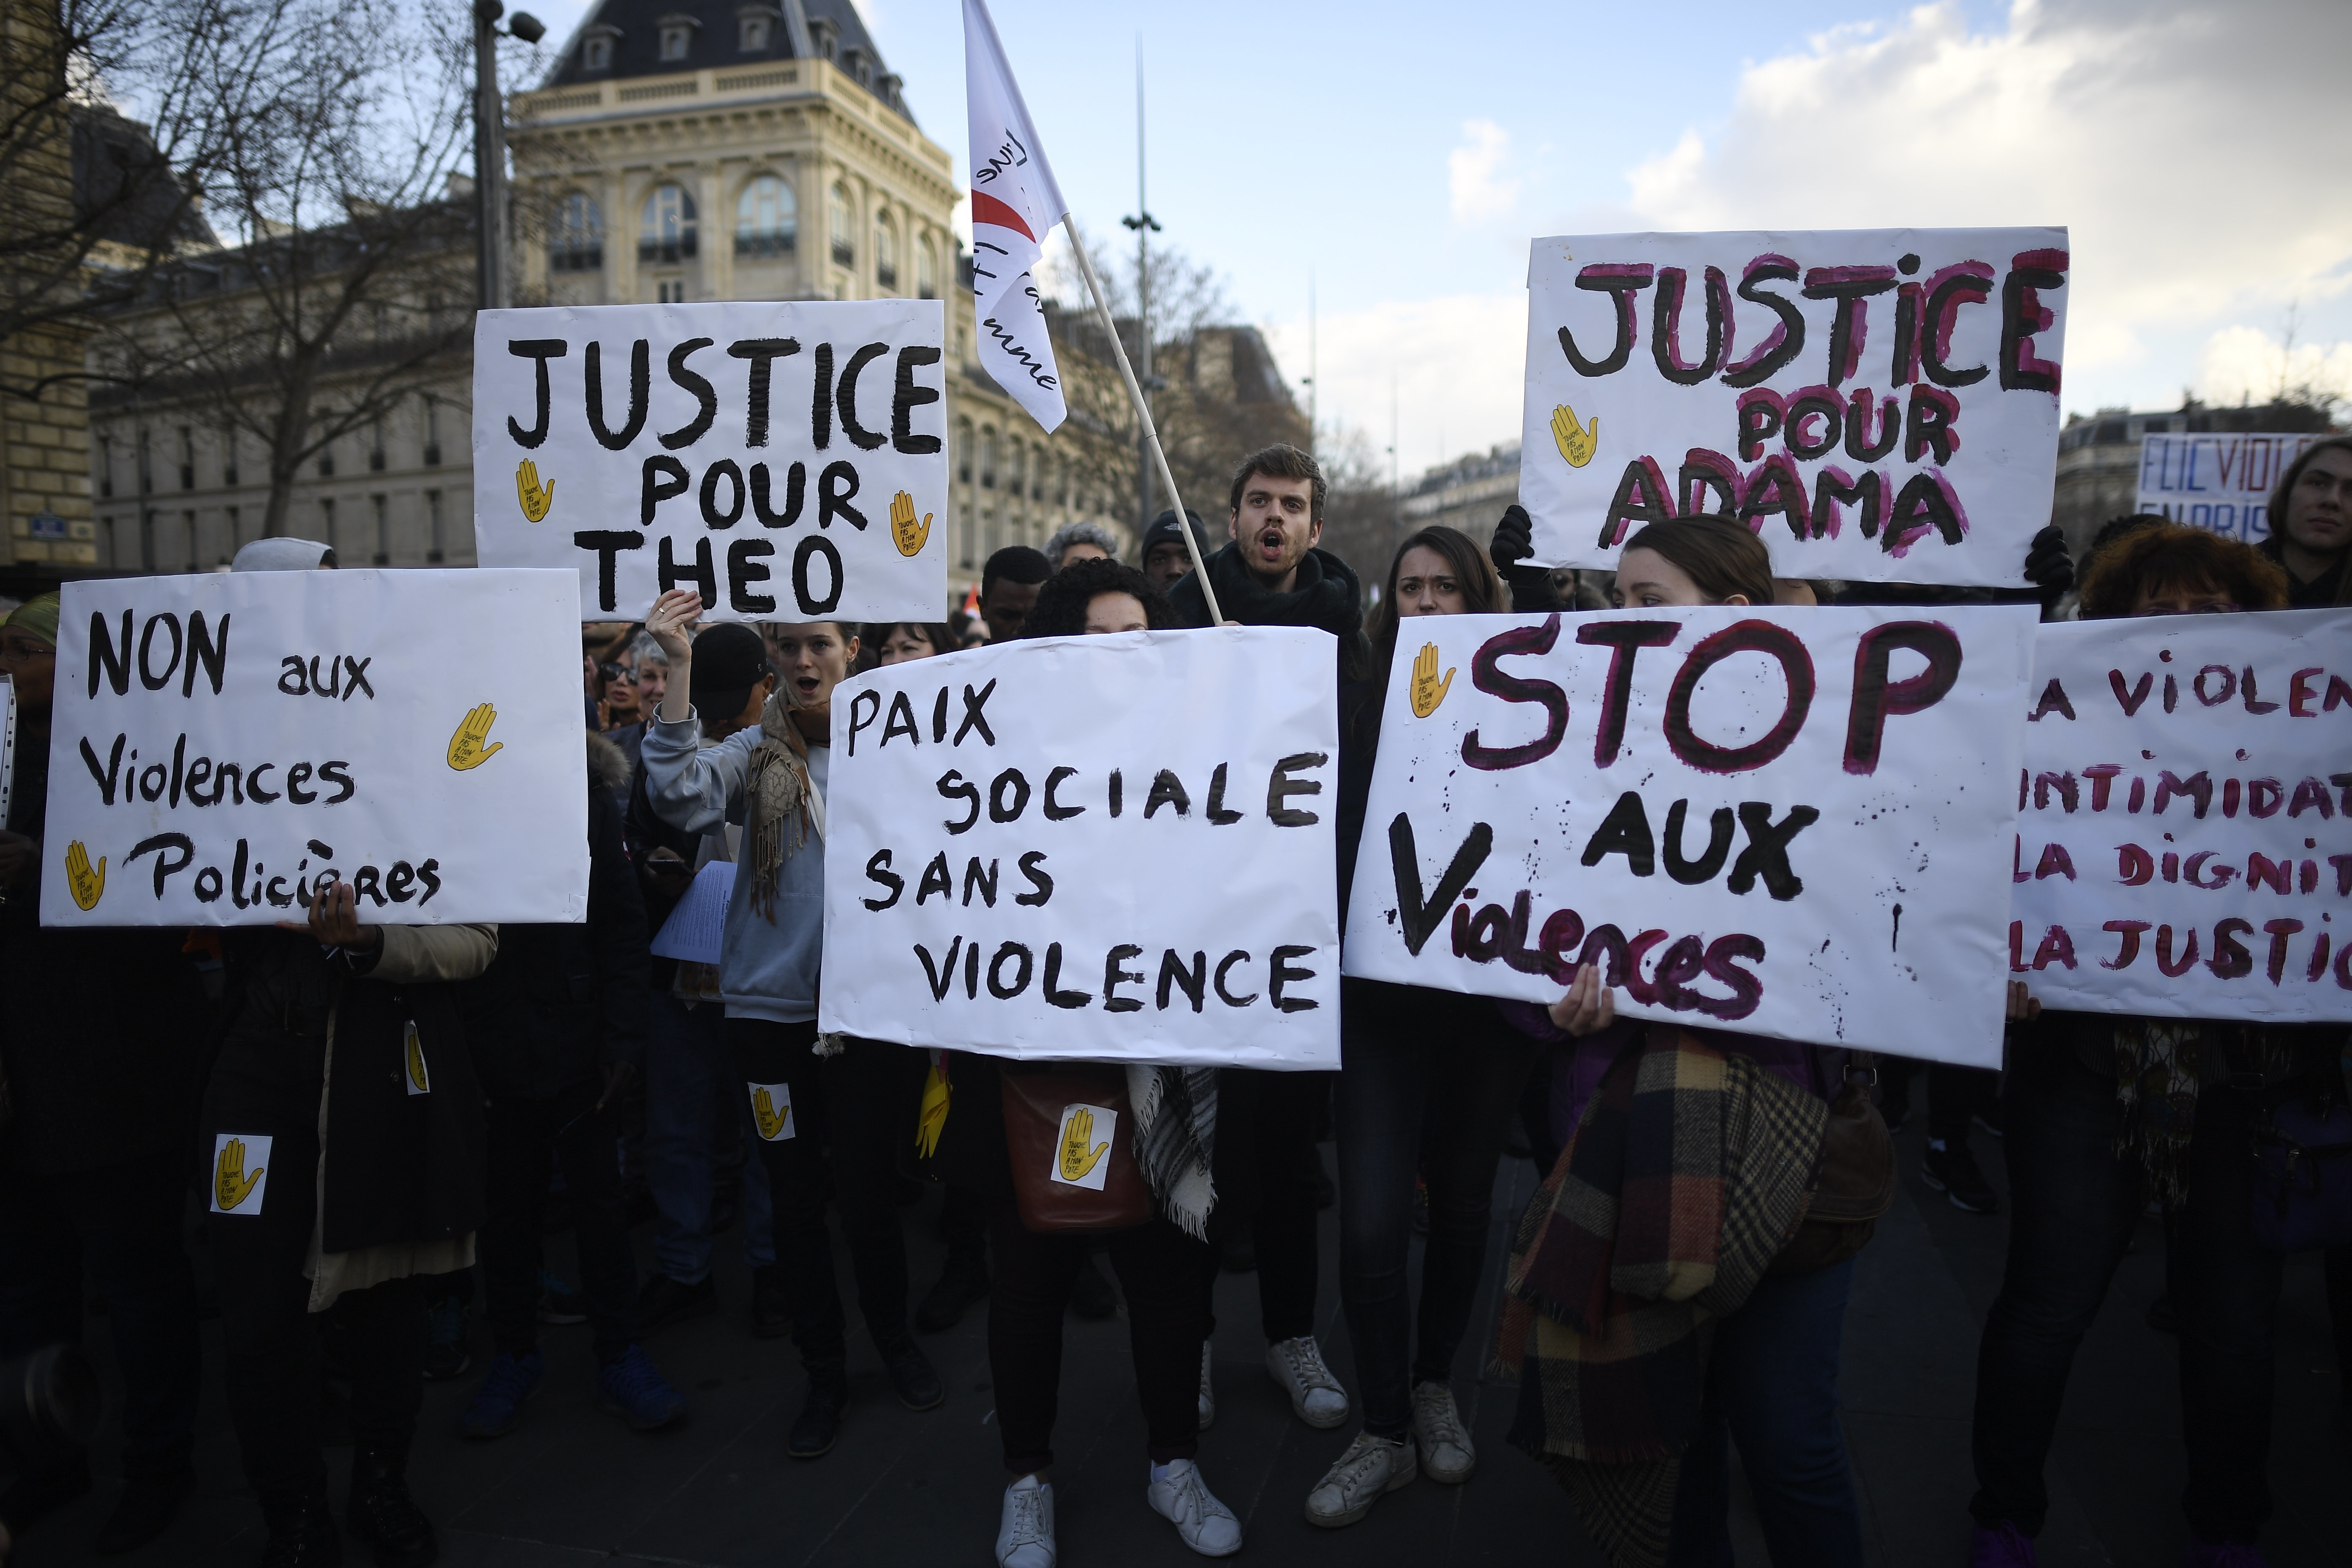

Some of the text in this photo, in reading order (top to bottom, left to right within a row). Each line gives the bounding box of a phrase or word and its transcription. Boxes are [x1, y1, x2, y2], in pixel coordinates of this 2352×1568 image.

[983, 318, 1056, 390] mme
[507, 337, 941, 455] JUSTICE
[1736, 383, 1960, 466] POUR
[1563, 428, 1580, 442] TOUCHE
[1567, 439, 1576, 449] PAS
[1574, 441, 1584, 454] MON
[1573, 450, 1587, 463] POTE
[2142, 438, 2211, 491] FLIC
[524, 485, 538, 496] TOUCHE
[641, 455, 868, 531] POUR
[531, 498, 540, 508] MON
[1598, 447, 1969, 558] ADAMA
[529, 508, 541, 517] POTE
[898, 519, 914, 529] TOUCHE
[900, 528, 908, 536] PAS
[905, 532, 916, 542] MON
[903, 542, 916, 551] POTE
[574, 531, 843, 615] THEO
[88, 609, 374, 702] NON aux
[1418, 674, 1436, 686] TOUCHE
[1418, 685, 1427, 695] PAS
[1418, 695, 1421, 703] A
[1422, 689, 1434, 701] MON
[1461, 613, 1963, 776] STOP
[1418, 701, 1431, 712] POTE
[2028, 678, 2076, 722] A
[848, 678, 996, 757] PAIX
[459, 739, 471, 747] PAS
[463, 731, 482, 742] TOUCHE
[460, 748, 475, 756] MON
[452, 754, 468, 764] POTE
[79, 733, 356, 809] Violences
[936, 752, 1329, 835] SOCIALE
[1581, 791, 1820, 902] AUX
[2013, 833, 2077, 883] LA
[74, 867, 90, 882] TOUCHE
[859, 849, 1055, 912] SANS
[84, 881, 93, 896] MON
[82, 892, 94, 905] POTE
[2009, 920, 2078, 972] LA
[913, 935, 1320, 1013] VIOLENCE
[1067, 1149, 1077, 1157] PAS
[1071, 1156, 1084, 1165] MON
[222, 1171, 241, 1179] TOUCHE
[1064, 1165, 1079, 1173] POTE
[221, 1179, 230, 1187] PAS
[225, 1185, 238, 1194] MON
[220, 1195, 234, 1203] POTE
